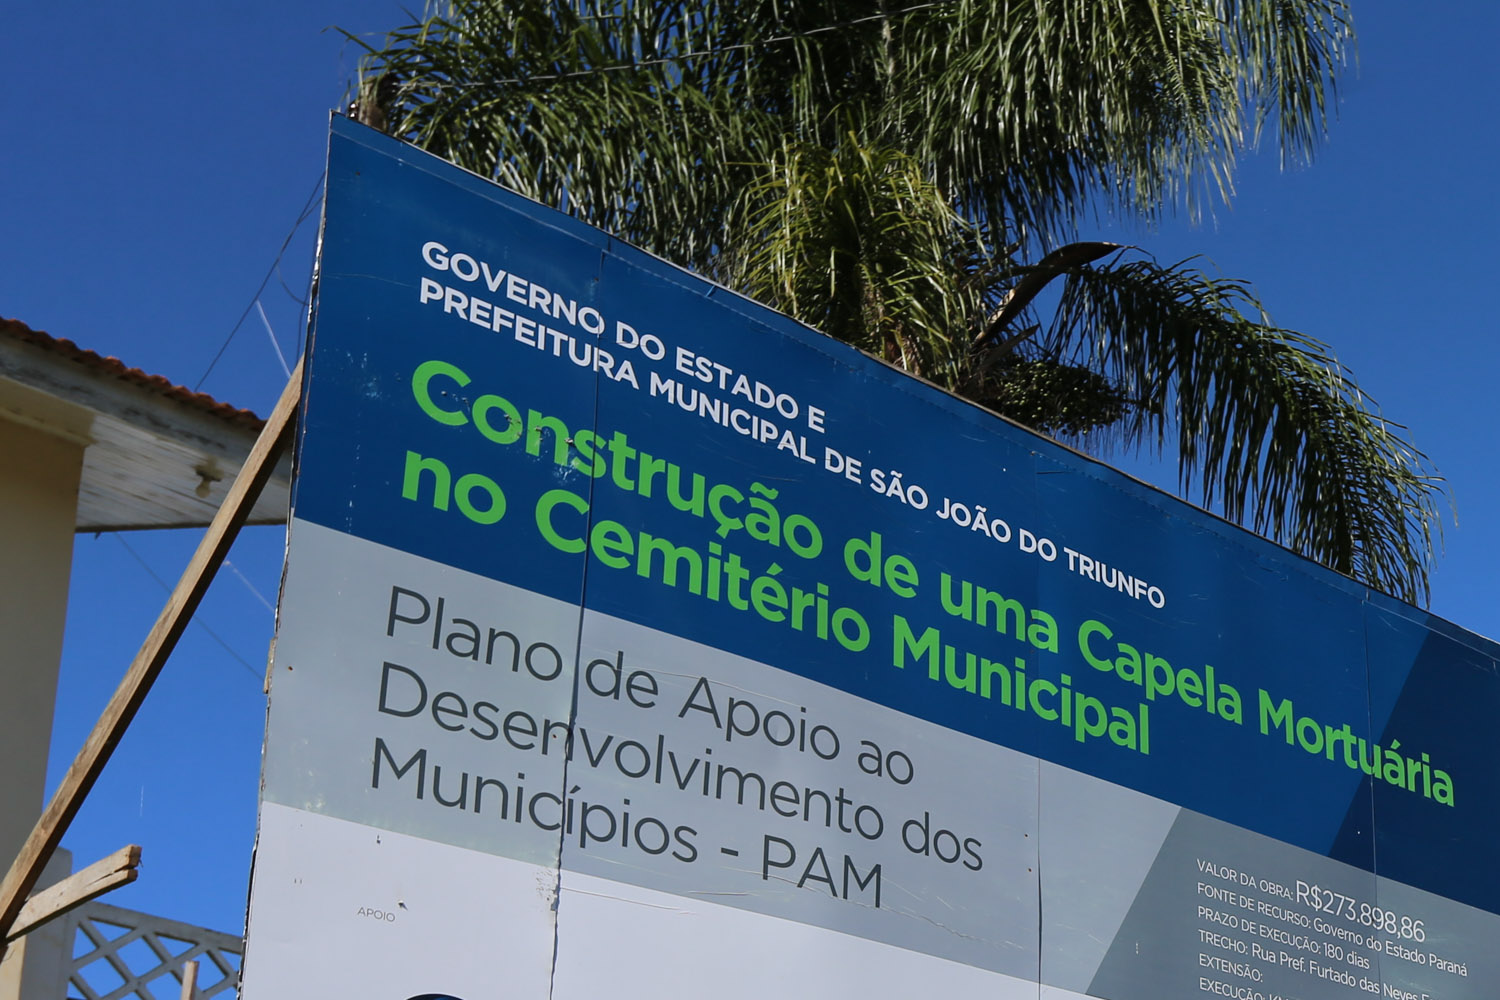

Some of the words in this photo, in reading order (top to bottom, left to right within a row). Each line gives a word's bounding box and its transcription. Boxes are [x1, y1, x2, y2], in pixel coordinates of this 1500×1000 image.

[421, 240, 605, 335] GOVERNO
[615, 320, 666, 360] DO
[675, 347, 799, 419] ESTADO
[807, 405, 826, 434] E
[420, 277, 639, 389] PREFEITURA
[649, 372, 816, 464] MUNICIPAL
[824, 446, 862, 485] DE
[869, 470, 928, 510] SÃO
[935, 497, 1011, 543] JOÃO
[1019, 528, 1057, 561] DO
[1063, 546, 1165, 609] TRIUNFO
[402, 449, 506, 525] no
[535, 489, 870, 652] Cemitério
[893, 614, 1150, 755] Municipal
[411, 360, 823, 559] Construção
[844, 531, 919, 599] de
[940, 572, 1059, 653] uma
[1078, 619, 1243, 725] Capela
[1258, 687, 1454, 807] Mortuária
[378, 661, 884, 841] Desenvolvimento
[901, 812, 983, 872] dos
[386, 585, 563, 682] Plano
[584, 651, 659, 710] de
[678, 677, 840, 761] Apoio
[856, 740, 914, 786] ao
[371, 737, 699, 864] Municípios
[761, 834, 883, 909] PAM
[1196, 858, 1237, 882] VALOR
[1240, 872, 1257, 889] DA
[1259, 879, 1293, 901] OBRA:
[1296, 880, 1426, 943] R$273.898,86
[357, 906, 396, 922] APOIO
[1197, 882, 1236, 906] FONTE
[1239, 895, 1255, 911] DE
[1257, 901, 1311, 929] RECURSO:
[1313, 918, 1363, 946] Governo
[1366, 936, 1382, 951] do
[1385, 941, 1426, 965] Estado
[1429, 956, 1468, 977] Paraná
[1198, 905, 1239, 929] PRAZO
[1241, 919, 1257, 935] DE
[1259, 924, 1321, 954] EXECUÇÃO:
[1323, 942, 1344, 961] 180
[1346, 951, 1370, 970] dias
[1198, 929, 1248, 955] TRECHO:
[1252, 942, 1276, 963] Rua
[1280, 953, 1306, 972] Pref.
[1309, 960, 1356, 987] Furtado
[1359, 977, 1380, 994] das
[1199, 953, 1263, 983] EXTENSÃO:
